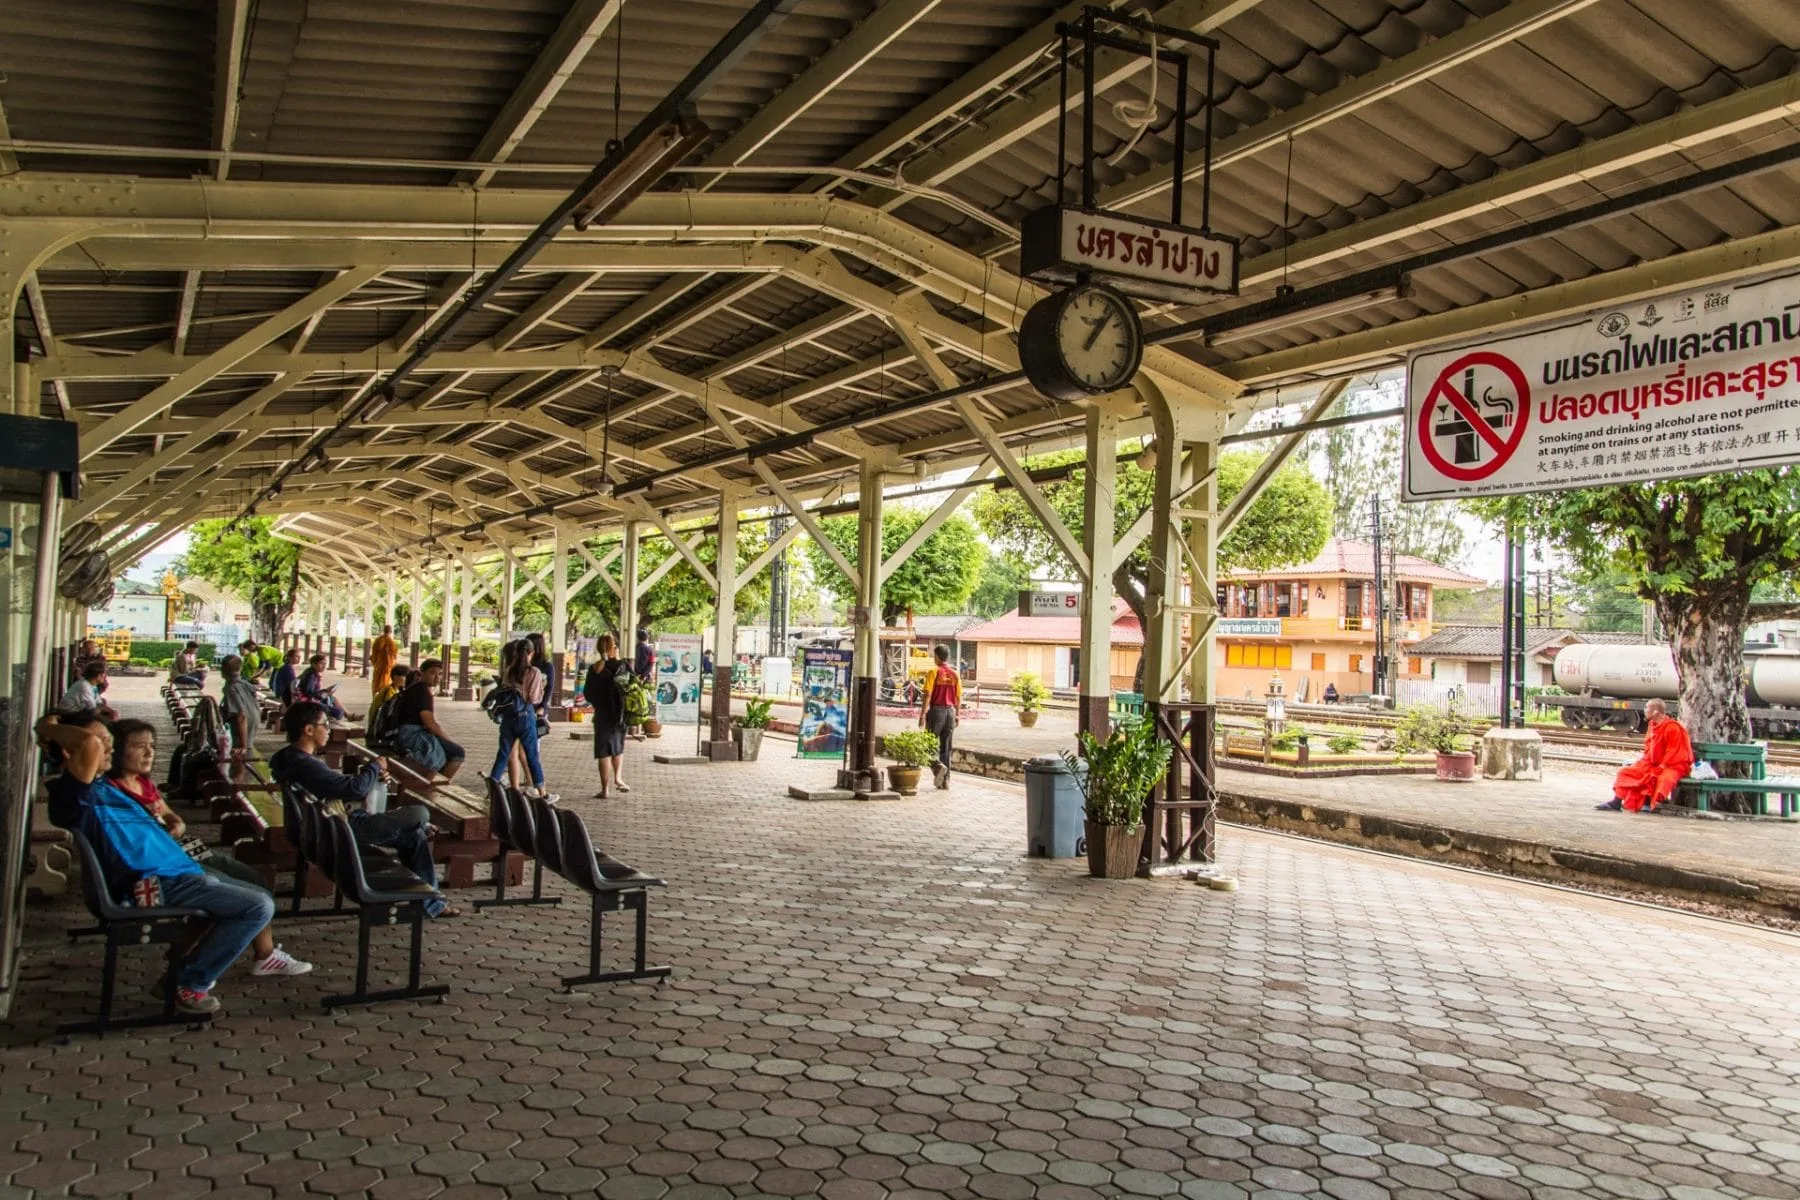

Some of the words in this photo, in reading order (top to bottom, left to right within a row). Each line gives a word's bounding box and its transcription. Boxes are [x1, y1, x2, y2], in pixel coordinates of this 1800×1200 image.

[1077, 224, 1220, 279] นครลำปาง
[1538, 431, 1582, 445] Smoking
[1584, 426, 1603, 438] and
[1605, 422, 1652, 436] drinking
[1654, 414, 1695, 429] alcohol
[1697, 413, 1717, 423] are
[1720, 408, 1743, 419] not
[1538, 446, 1548, 456] at
[1550, 443, 1590, 456] anytime
[1591, 441, 1606, 450] on
[1608, 436, 1639, 448] trains
[1641, 434, 1654, 444] or
[1655, 432, 1666, 442] at
[1668, 429, 1688, 440] any
[1691, 423, 1744, 437] stations.
[1065, 595, 1077, 608] 5
